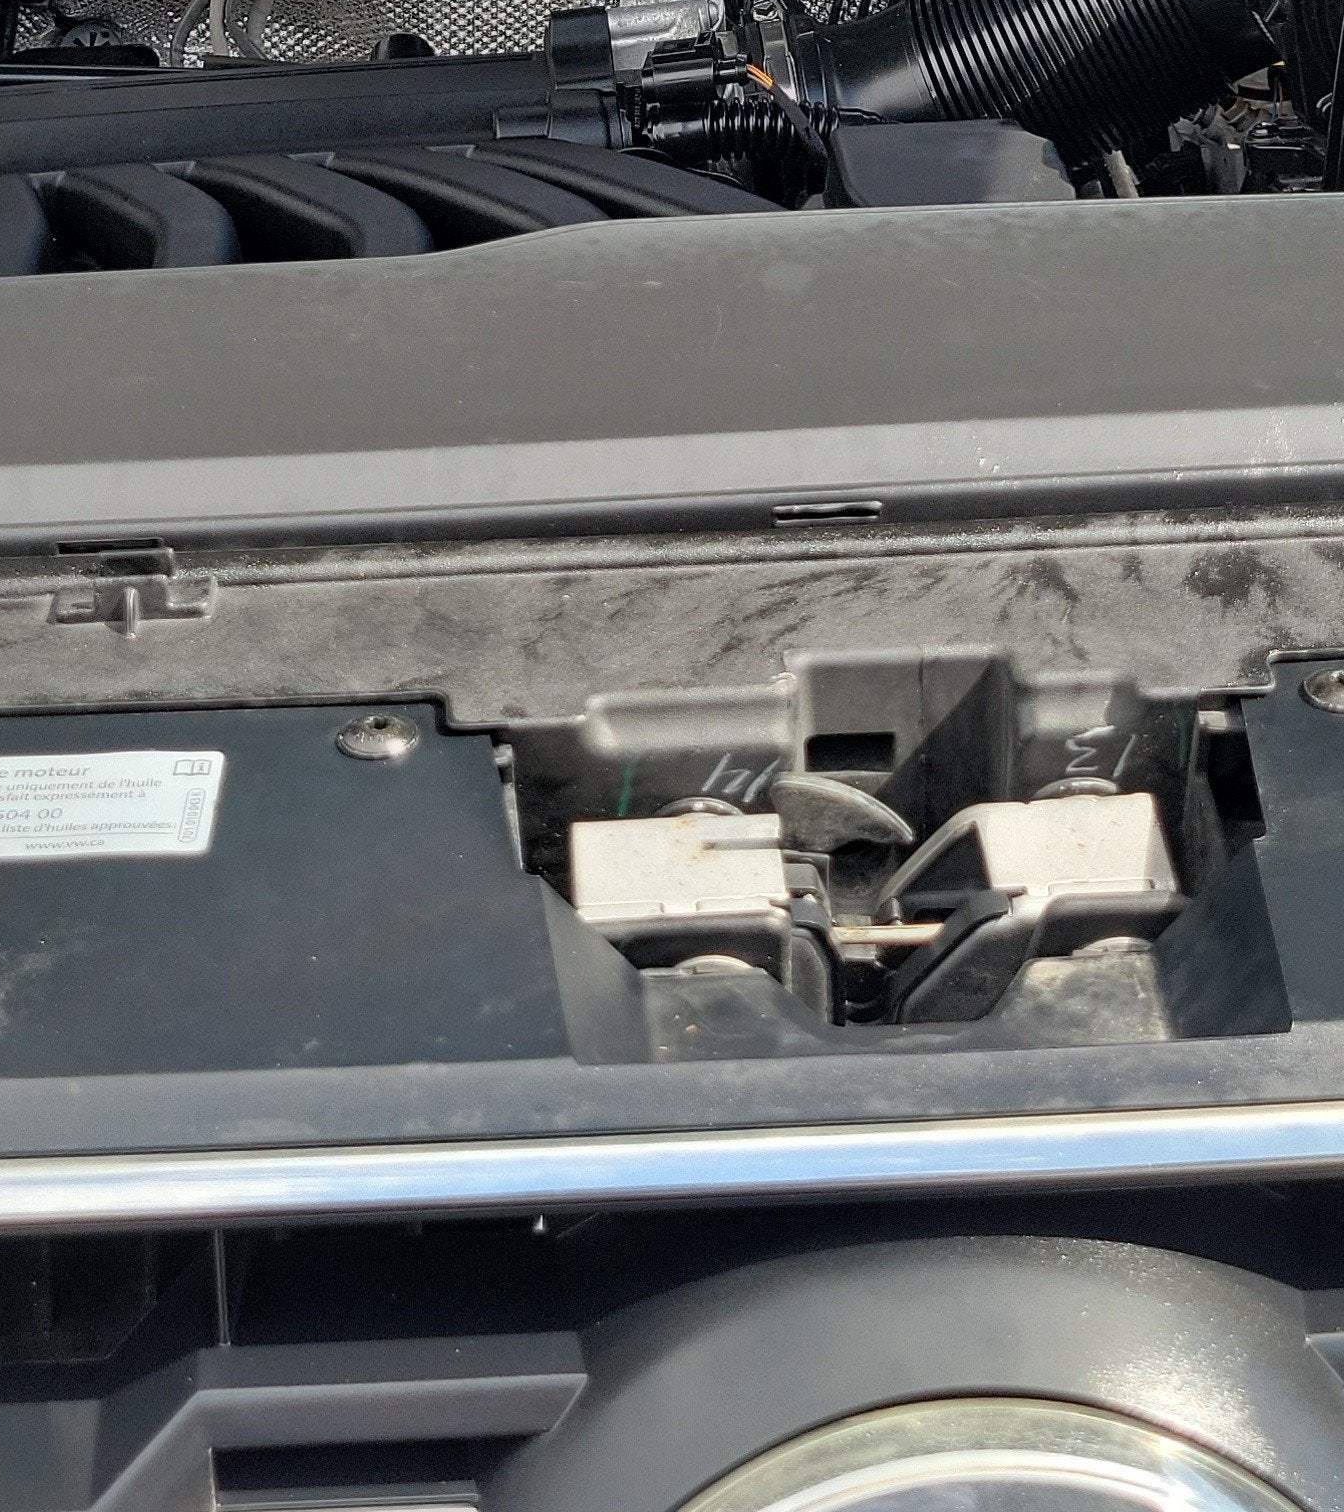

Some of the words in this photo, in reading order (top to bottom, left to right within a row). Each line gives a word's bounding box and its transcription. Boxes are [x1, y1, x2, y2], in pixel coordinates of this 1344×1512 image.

[13, 766, 91, 778] moteur
[8, 779, 98, 793] uniquement
[100, 778, 115, 788] de
[35, 807, 64, 820] 00
[0, 822, 32, 833] liste
[22, 838, 106, 850] www.vw.ca
